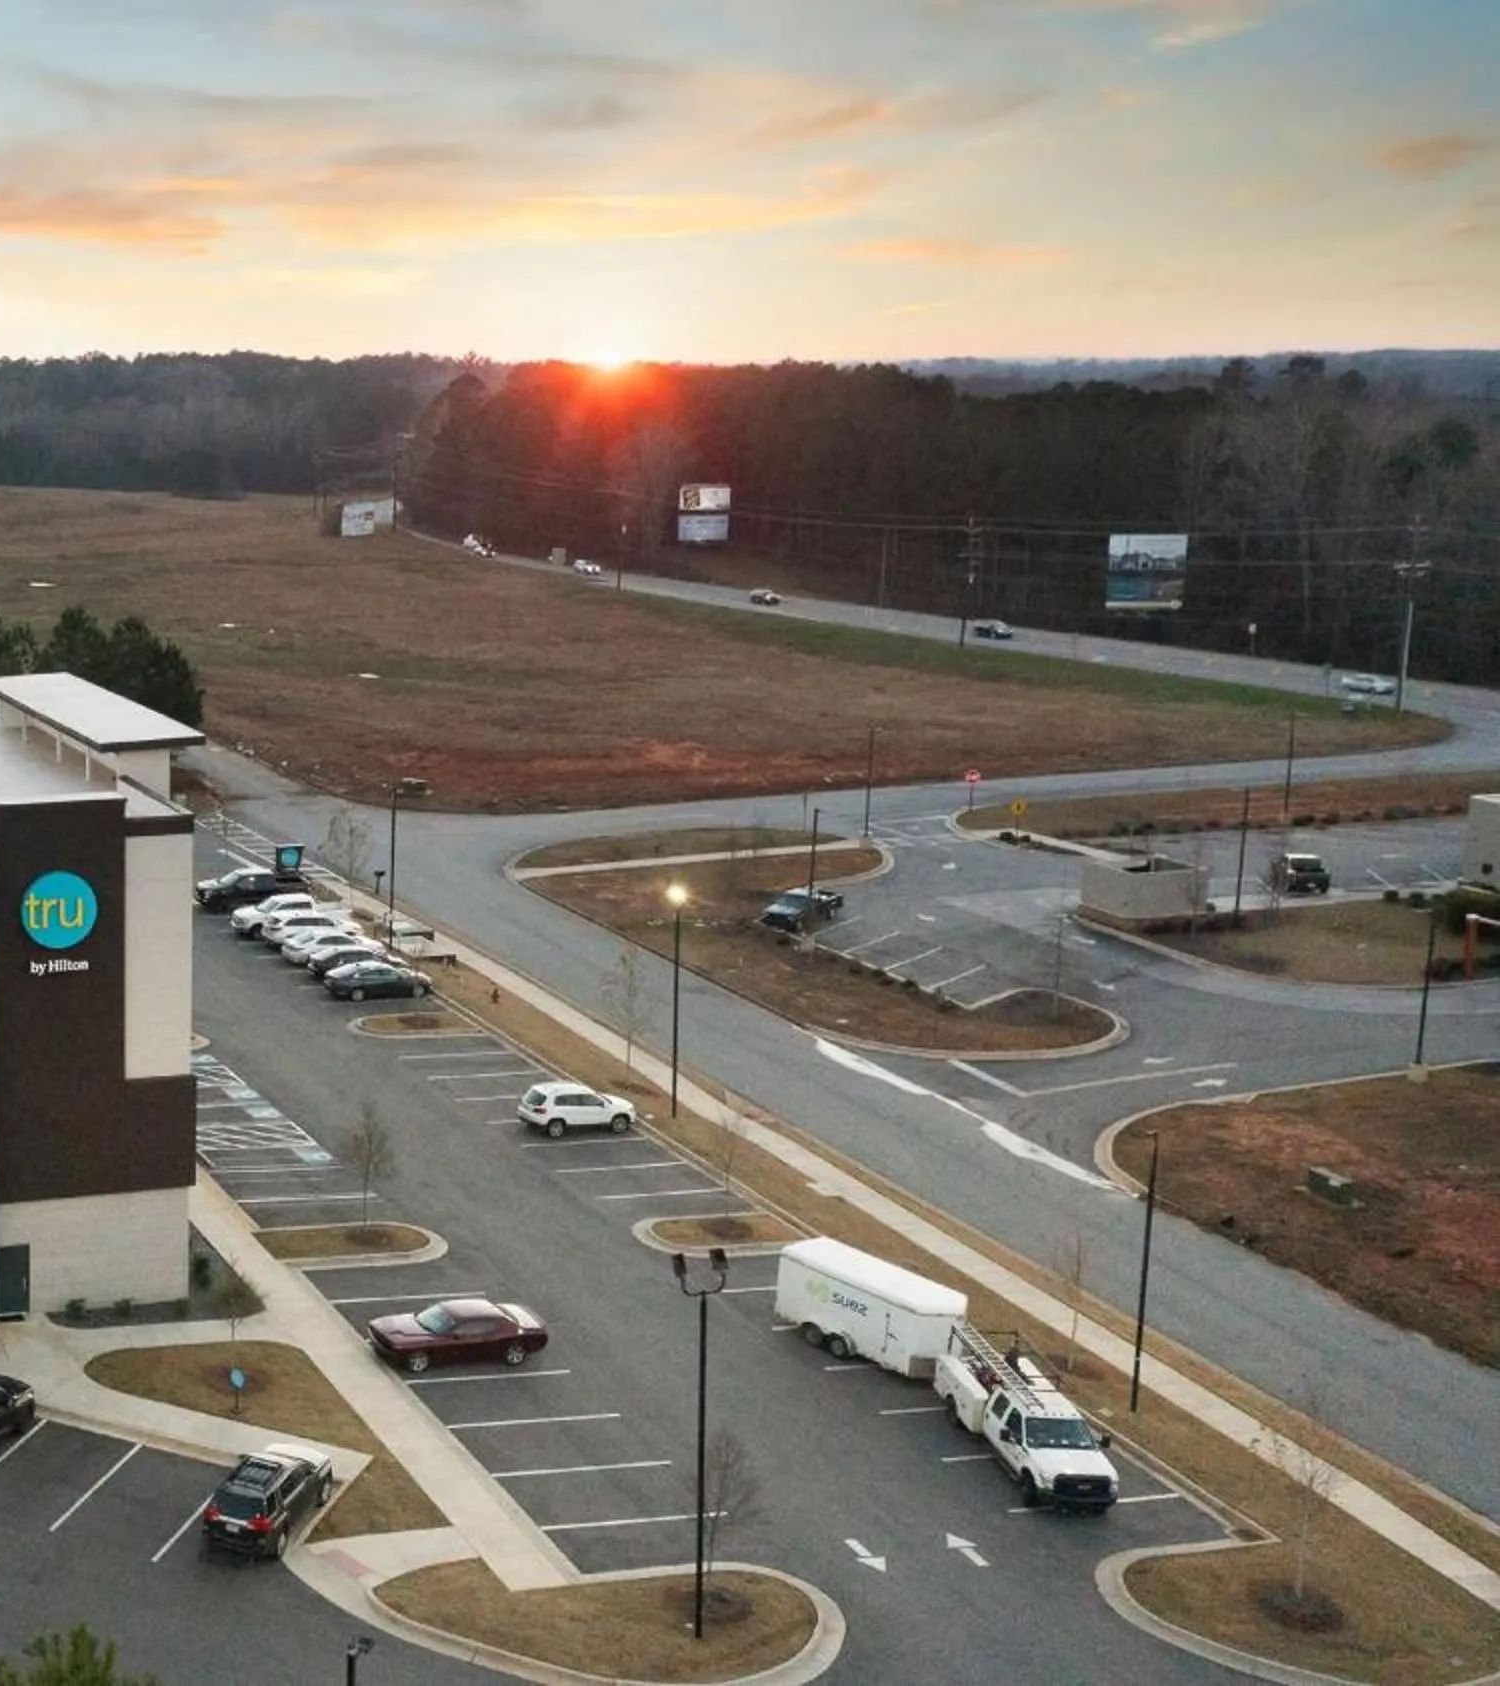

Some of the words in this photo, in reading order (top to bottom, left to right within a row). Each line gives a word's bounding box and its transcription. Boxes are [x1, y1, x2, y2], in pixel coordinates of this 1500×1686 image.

[25, 892, 83, 929] tru
[30, 961, 46, 976] by
[48, 959, 89, 973] Hilton
